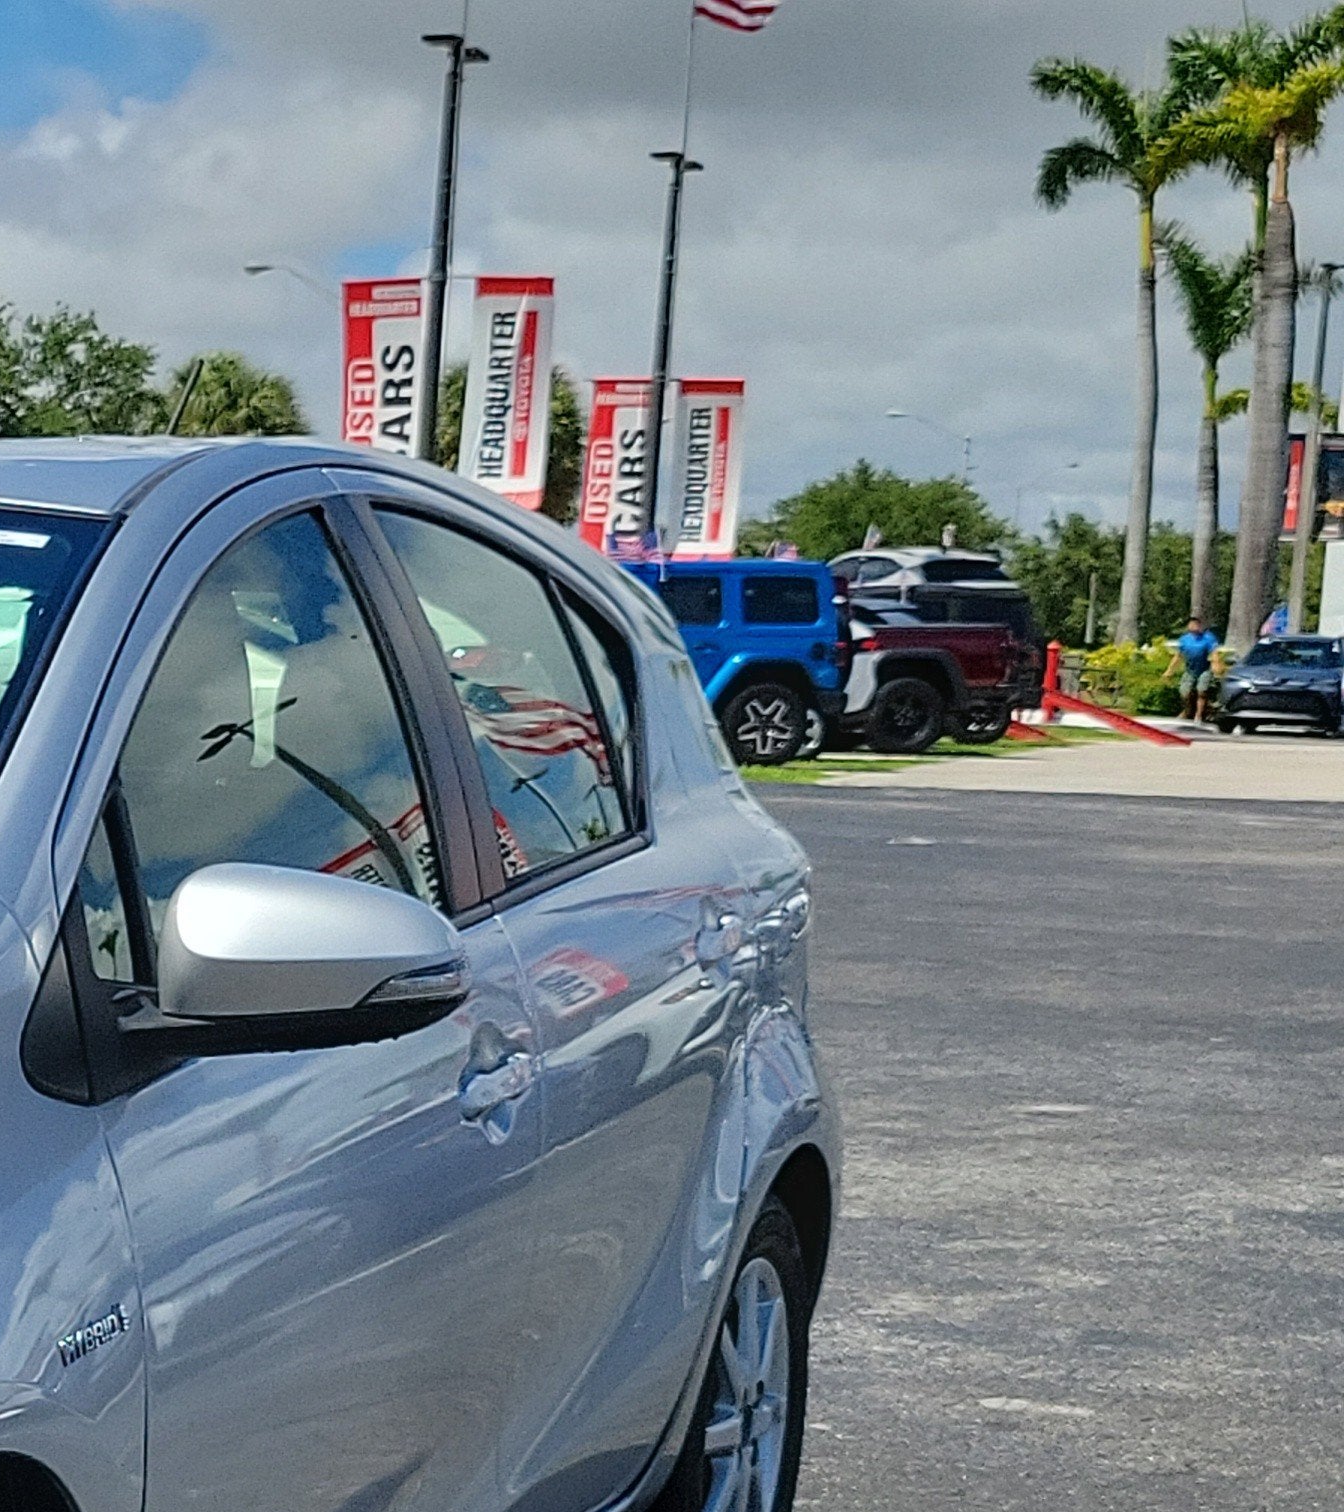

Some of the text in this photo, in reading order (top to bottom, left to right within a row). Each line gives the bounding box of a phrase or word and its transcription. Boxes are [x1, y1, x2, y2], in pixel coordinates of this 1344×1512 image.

[379, 345, 415, 455] ARS
[477, 310, 518, 480] HEADQUARTER
[587, 441, 613, 519] USED
[613, 429, 646, 536] CARS
[680, 407, 712, 543] HEADQUARTER
[57, 1303, 130, 1368] HYBRID
